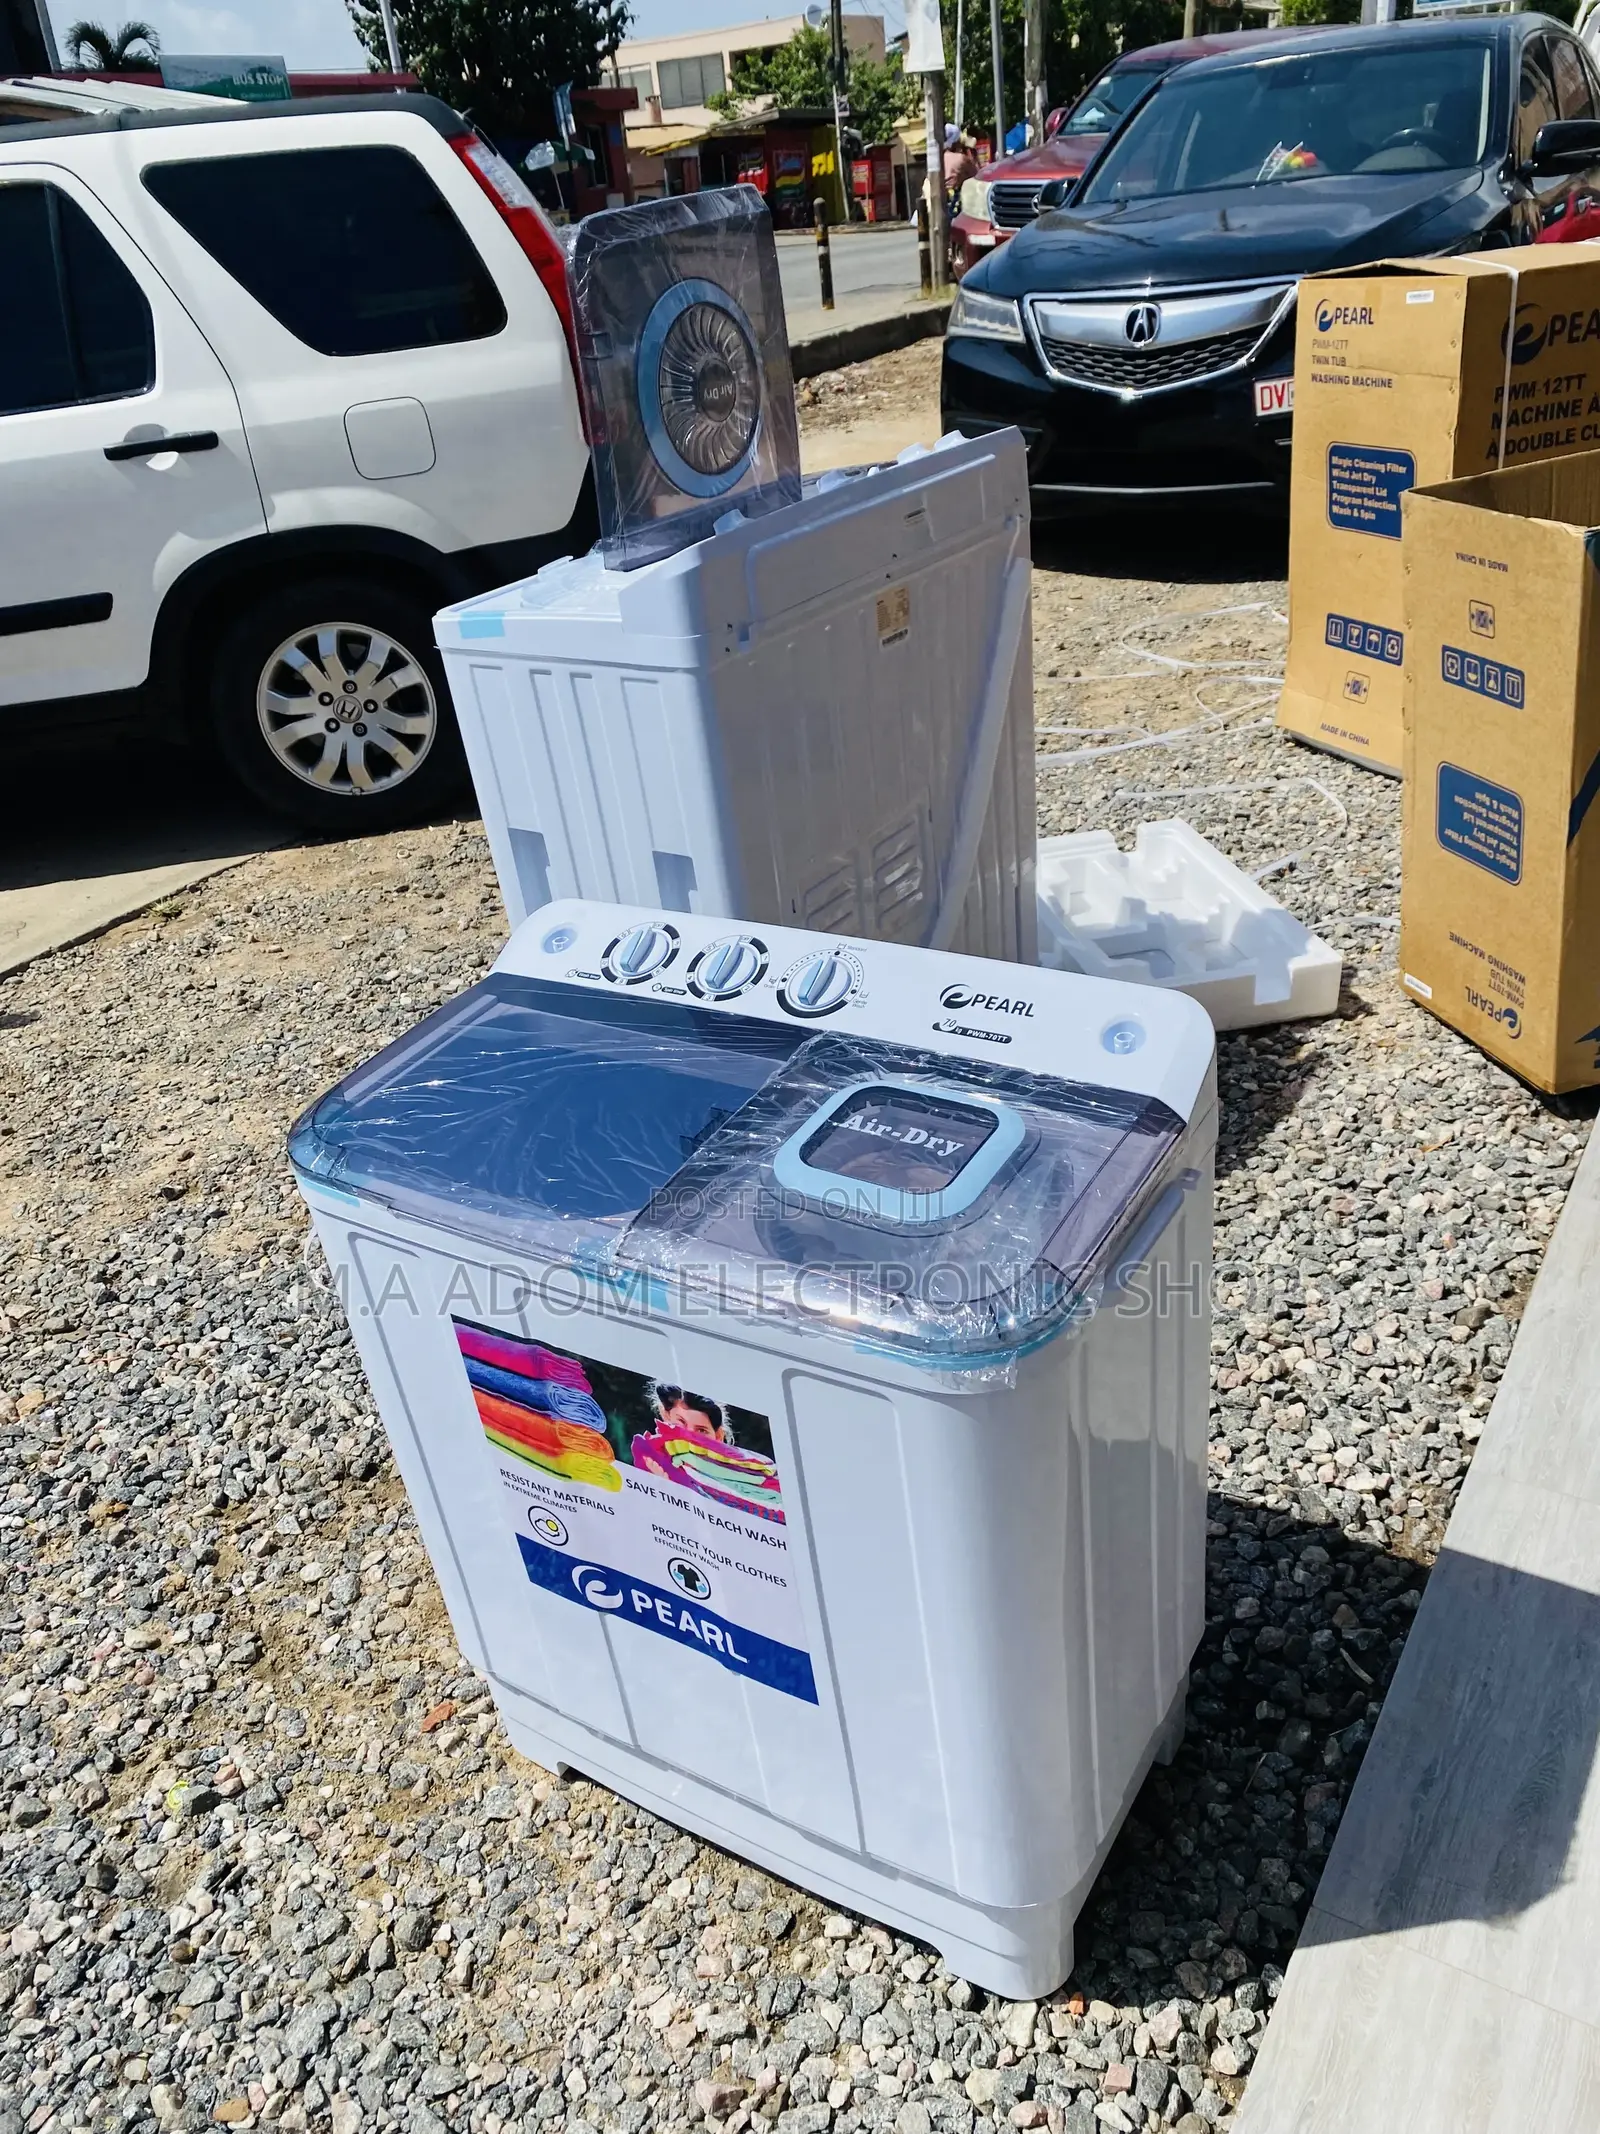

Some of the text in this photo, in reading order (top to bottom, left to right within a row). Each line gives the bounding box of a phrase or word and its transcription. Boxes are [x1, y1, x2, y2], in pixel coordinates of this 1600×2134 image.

[1334, 307, 1374, 325] PEARL
[1312, 355, 1346, 367] TWIN TUB
[1311, 373, 1393, 388] WASHING MACHINE
[1494, 373, 1587, 403] PWM-12TT
[1491, 398, 1583, 430] MACHINE
[1504, 427, 1577, 457] DOUBLE
[1363, 472, 1376, 484] Dry
[1376, 486, 1387, 497] Lid
[1456, 552, 1509, 572] MADE IN CHINA
[1320, 722, 1370, 746] MADE IN CHINA
[1450, 932, 1526, 986] WASHING MACHINE
[1490, 969, 1525, 998] TWIN TUB
[970, 994, 1034, 1018] PEARL
[1464, 986, 1503, 1023] PEARL
[966, 1029, 1008, 1042] PWM-70TT
[839, 1114, 964, 1156] Air-Dry
[500, 1468, 615, 1516] RESISTANT MATERIALS
[512, 1483, 541, 1501] EXTREME
[542, 1496, 577, 1513] CLIMATES
[626, 1478, 788, 1551] SAVE TIME IN EACH WASH
[652, 1524, 788, 1588] PROTECT YOUR CLOTHES
[654, 1536, 720, 1571] EFFICIENTLY WASH
[631, 1588, 749, 1664] PEARL
